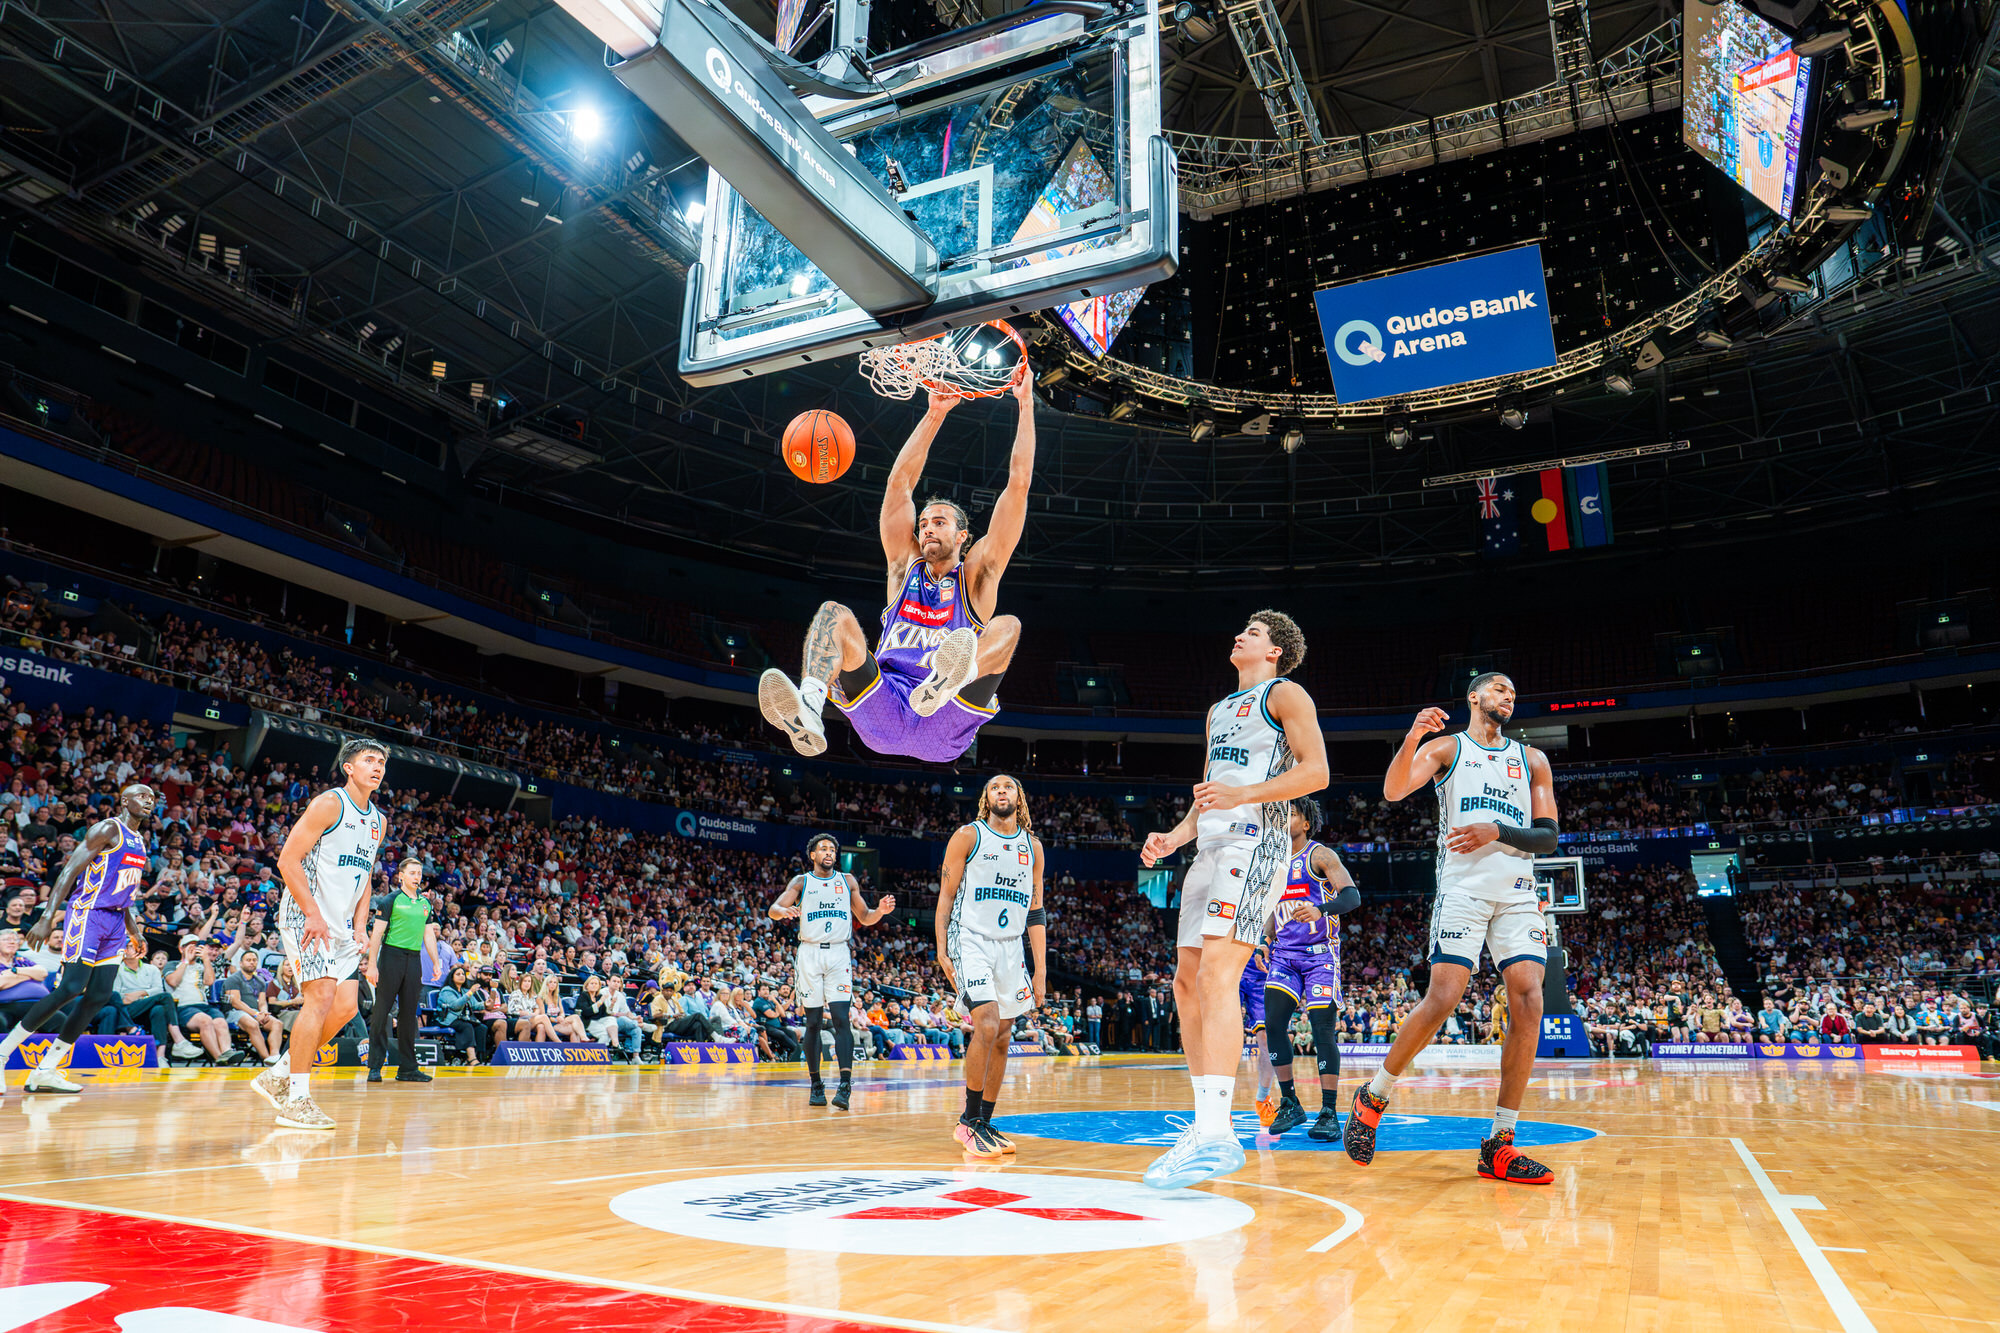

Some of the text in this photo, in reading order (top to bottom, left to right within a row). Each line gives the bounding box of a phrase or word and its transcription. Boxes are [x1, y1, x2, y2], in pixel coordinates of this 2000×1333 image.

[734, 80, 836, 189] Qudos Bank Arena
[1386, 289, 1538, 334] Qudos Bank
[1393, 330, 1467, 358] Arena
[817, 436, 829, 481] SPALDING
[903, 603, 949, 622] Harvey Norman
[18, 658, 74, 685] Bank
[1553, 769, 1639, 782] osbankarena.com.au
[1483, 782, 1509, 800] bnz
[1460, 796, 1525, 827] BREAKERS
[699, 816, 757, 834] Qudos Bank
[698, 828, 729, 841] Arena
[356, 843, 369, 858] bnz
[1567, 842, 1639, 855] Qudos Bank
[1583, 857, 1605, 865] ena
[995, 872, 1018, 888] bnz
[974, 887, 1030, 908] BREAKERS
[819, 901, 836, 910] bnz
[807, 909, 848, 922] BREAKERS
[997, 908, 1009, 929] 6
[824, 921, 832, 933] 8
[1440, 929, 1463, 939] bnz
[967, 978, 987, 988] bnz
[507, 1047, 610, 1062] BUILT FOR SYDNEY
[1353, 1045, 1391, 1054] BASKETBA
[1658, 1045, 1748, 1055] SYDNEY BASKETBALL
[1880, 1047, 1963, 1057] Harvey Norman
[683, 1176, 883, 1208] MOTORS
[705, 1177, 956, 1221] MITSUBISHI
